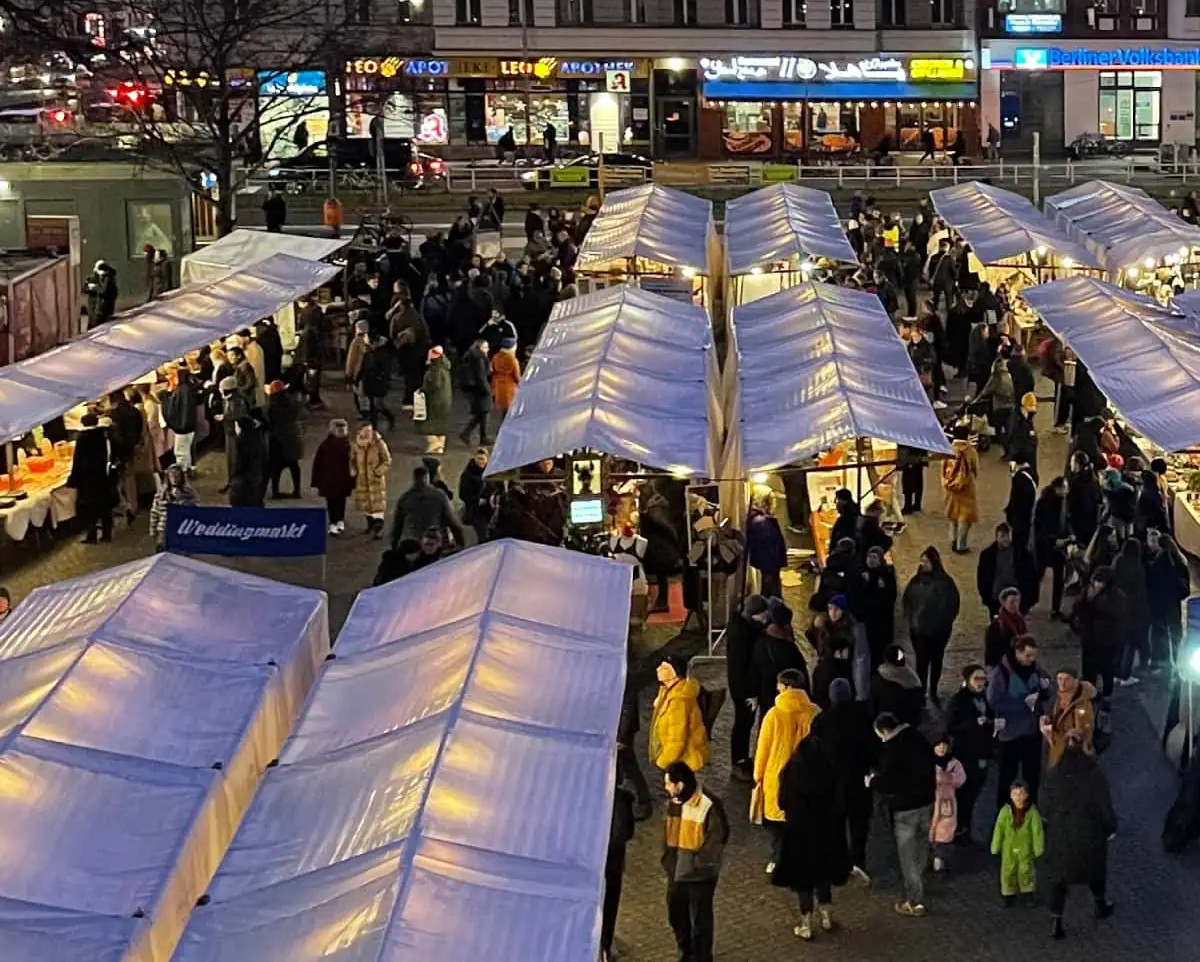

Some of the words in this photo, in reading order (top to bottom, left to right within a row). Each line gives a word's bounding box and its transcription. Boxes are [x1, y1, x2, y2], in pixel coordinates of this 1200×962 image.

[1049, 46, 1116, 65] Berliner
[500, 61, 533, 74] LEO
[176, 517, 309, 542] Weddingmarkt
